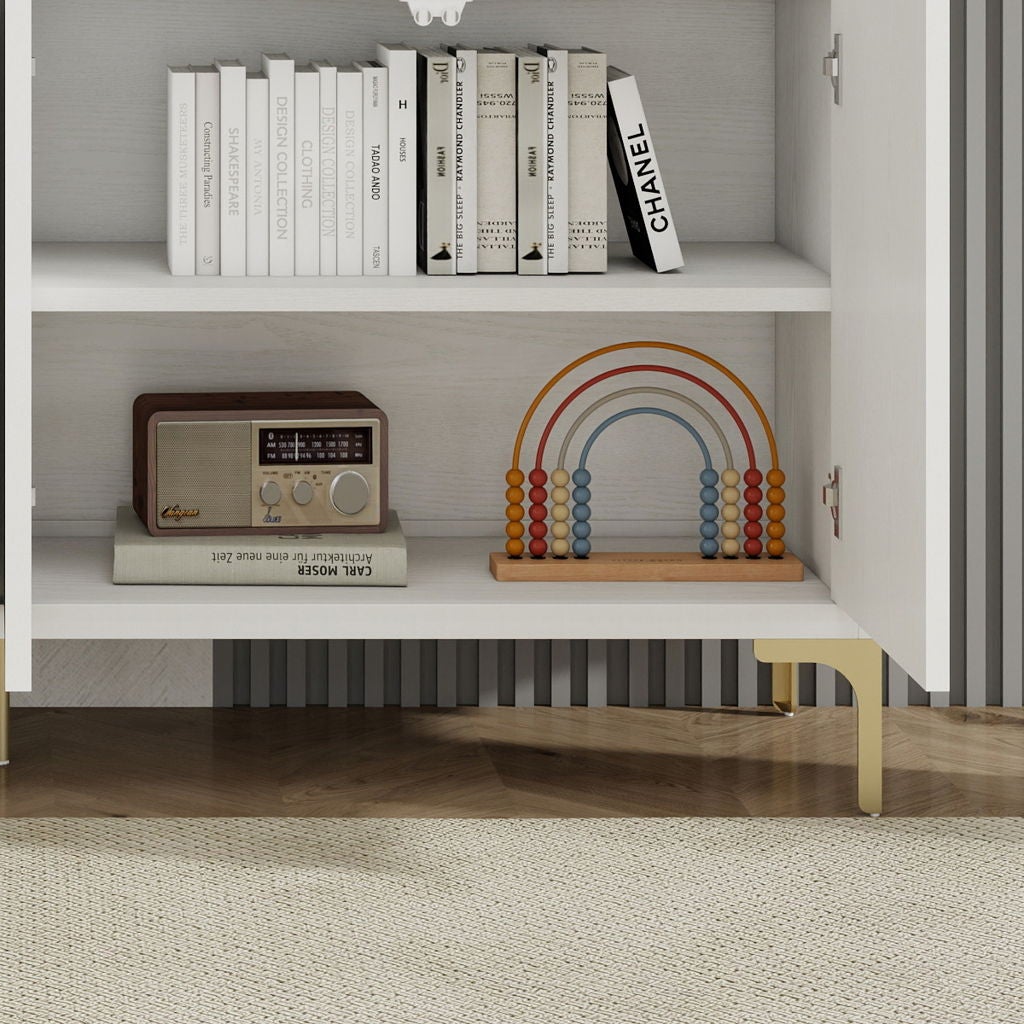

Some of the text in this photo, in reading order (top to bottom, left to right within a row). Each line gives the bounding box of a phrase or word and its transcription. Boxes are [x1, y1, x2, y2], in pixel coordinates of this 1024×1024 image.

[201, 120, 214, 173] Constructing
[227, 127, 240, 217] SHAKESPEARE
[276, 96, 288, 240] DESIGN COLLECTION
[301, 140, 313, 209] CLOTHING
[321, 107, 336, 237] DESIGN COLLECTION
[344, 110, 356, 239] DESIGN COLLECTION
[371, 144, 381, 201] TADAO ANDO
[399, 137, 407, 163] HOUSES
[456, 81, 464, 259] THE BIG SLEEP RAYMOND CHANDLER
[547, 81, 555, 259] THE BIG SLEEP RAYMOND CHANDLER
[627, 122, 669, 233] CHANEL
[211, 552, 373, 565] Architektur für eine neue Zeit
[297, 564, 373, 577] CARL MOSER
